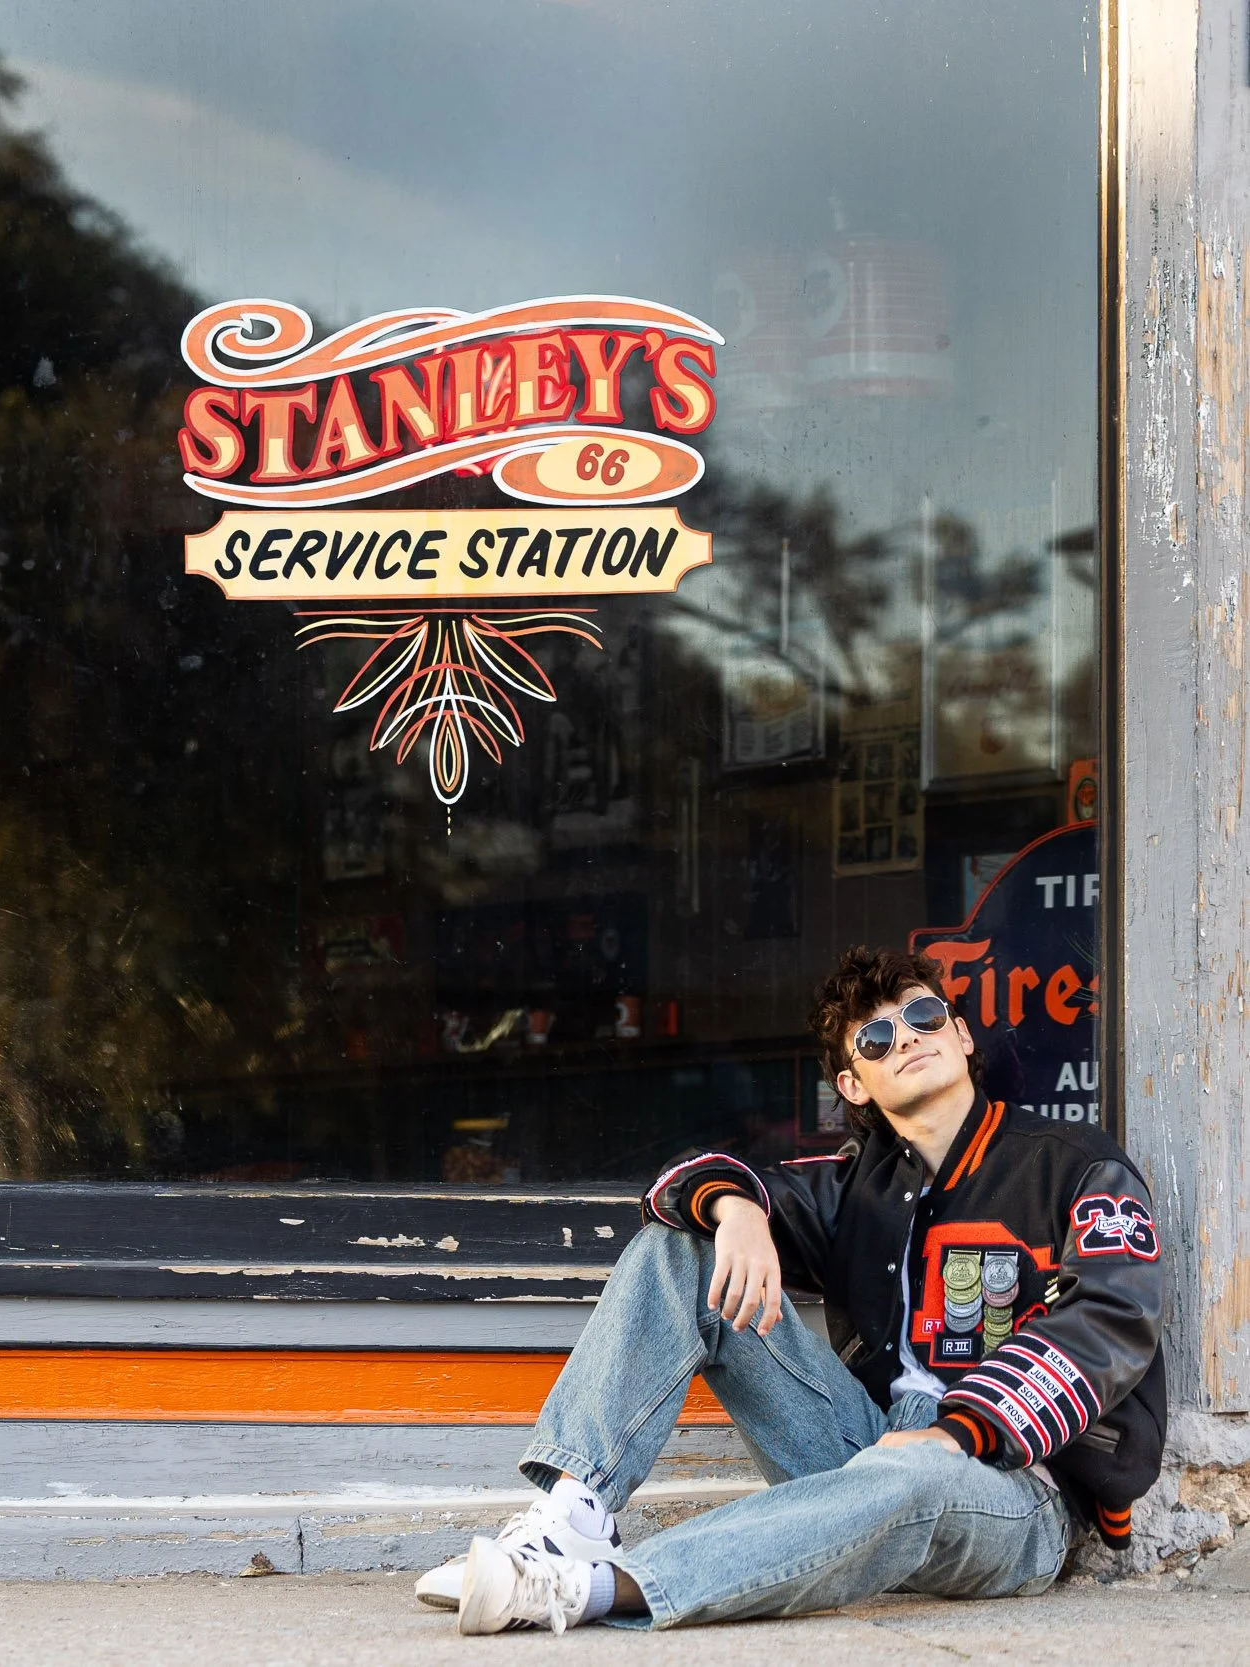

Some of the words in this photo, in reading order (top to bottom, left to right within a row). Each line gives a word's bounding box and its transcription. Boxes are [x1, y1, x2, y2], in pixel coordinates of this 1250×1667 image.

[178, 327, 717, 483] STANLEY'S
[576, 443, 630, 486] 66
[215, 529, 447, 580] SERVICE
[459, 527, 678, 578] STATION
[1070, 1193, 1161, 1261] 26
[1047, 1351, 1076, 1379] SENIOR
[1020, 1386, 1042, 1409] SOPH
[1030, 1369, 1059, 1398] JUNIOR
[1000, 1399, 1027, 1428] FROSH
